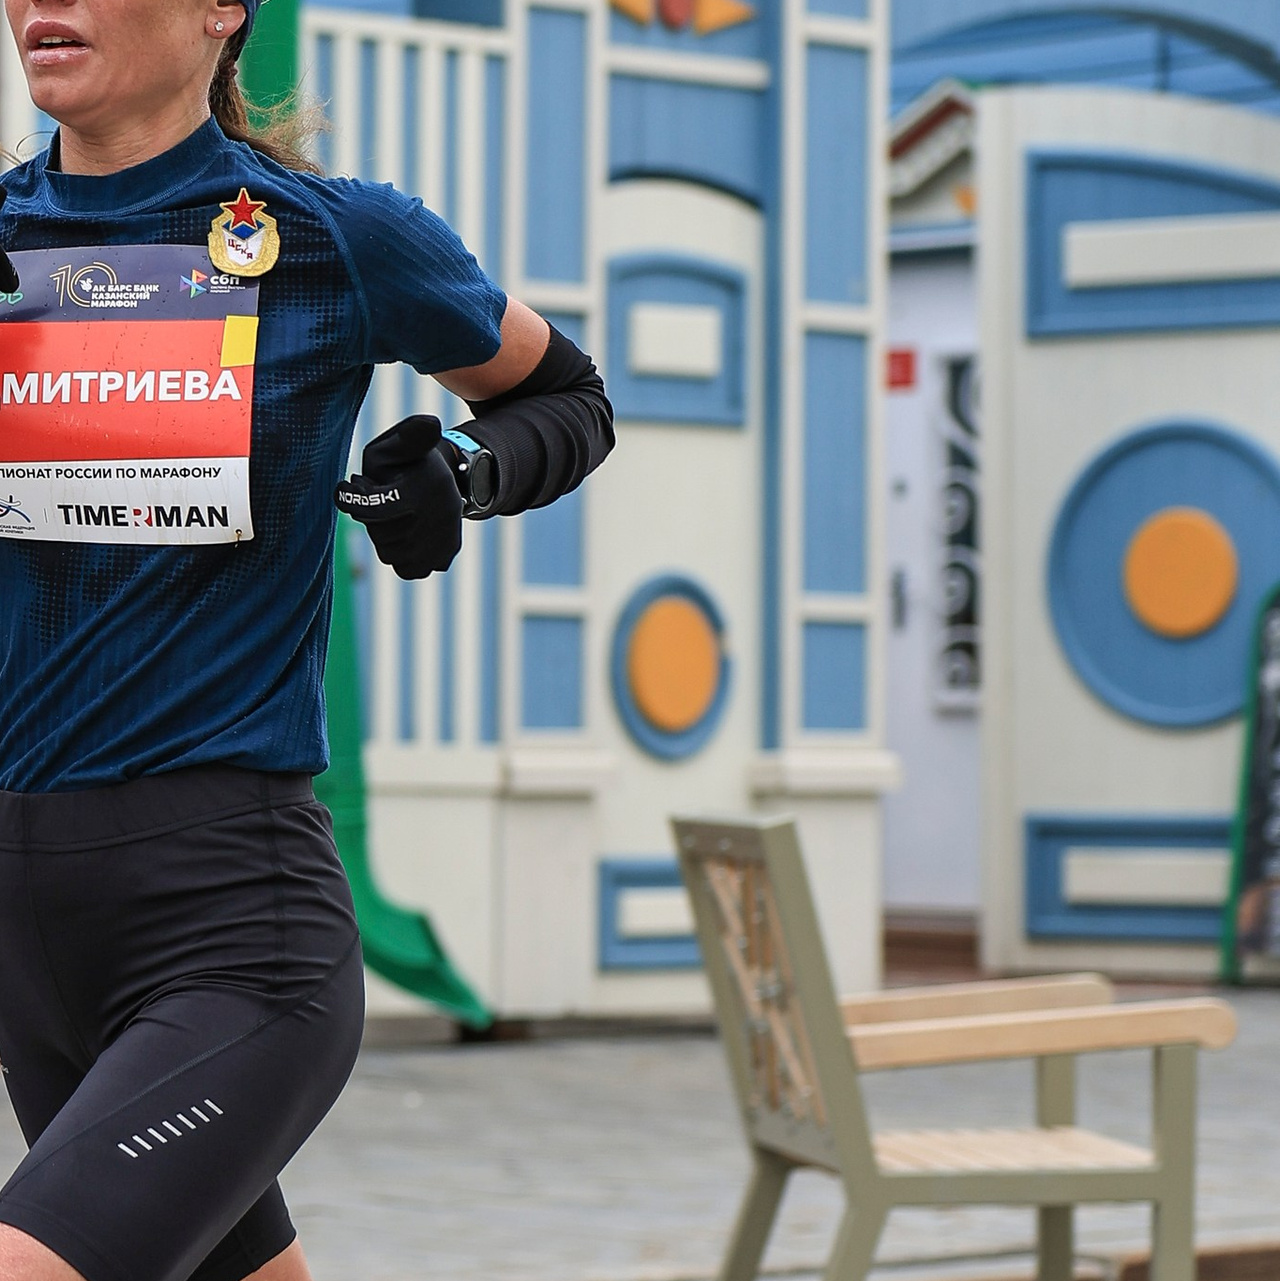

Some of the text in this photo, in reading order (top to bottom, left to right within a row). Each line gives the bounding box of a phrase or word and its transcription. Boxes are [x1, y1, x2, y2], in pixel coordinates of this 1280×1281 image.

[228, 239, 253, 259] ЦСКА
[92, 284, 160, 293] АК БАРС БАНК
[91, 291, 151, 300] КАЗАНСКИЙ
[90, 299, 138, 308] МАРАФОН
[55, 468, 112, 479] РОССИИ
[116, 468, 136, 479] ПО
[140, 467, 221, 479] МАРАФОНУ
[338, 488, 400, 506] NORDSKI
[57, 505, 229, 527] TIMERMAN
